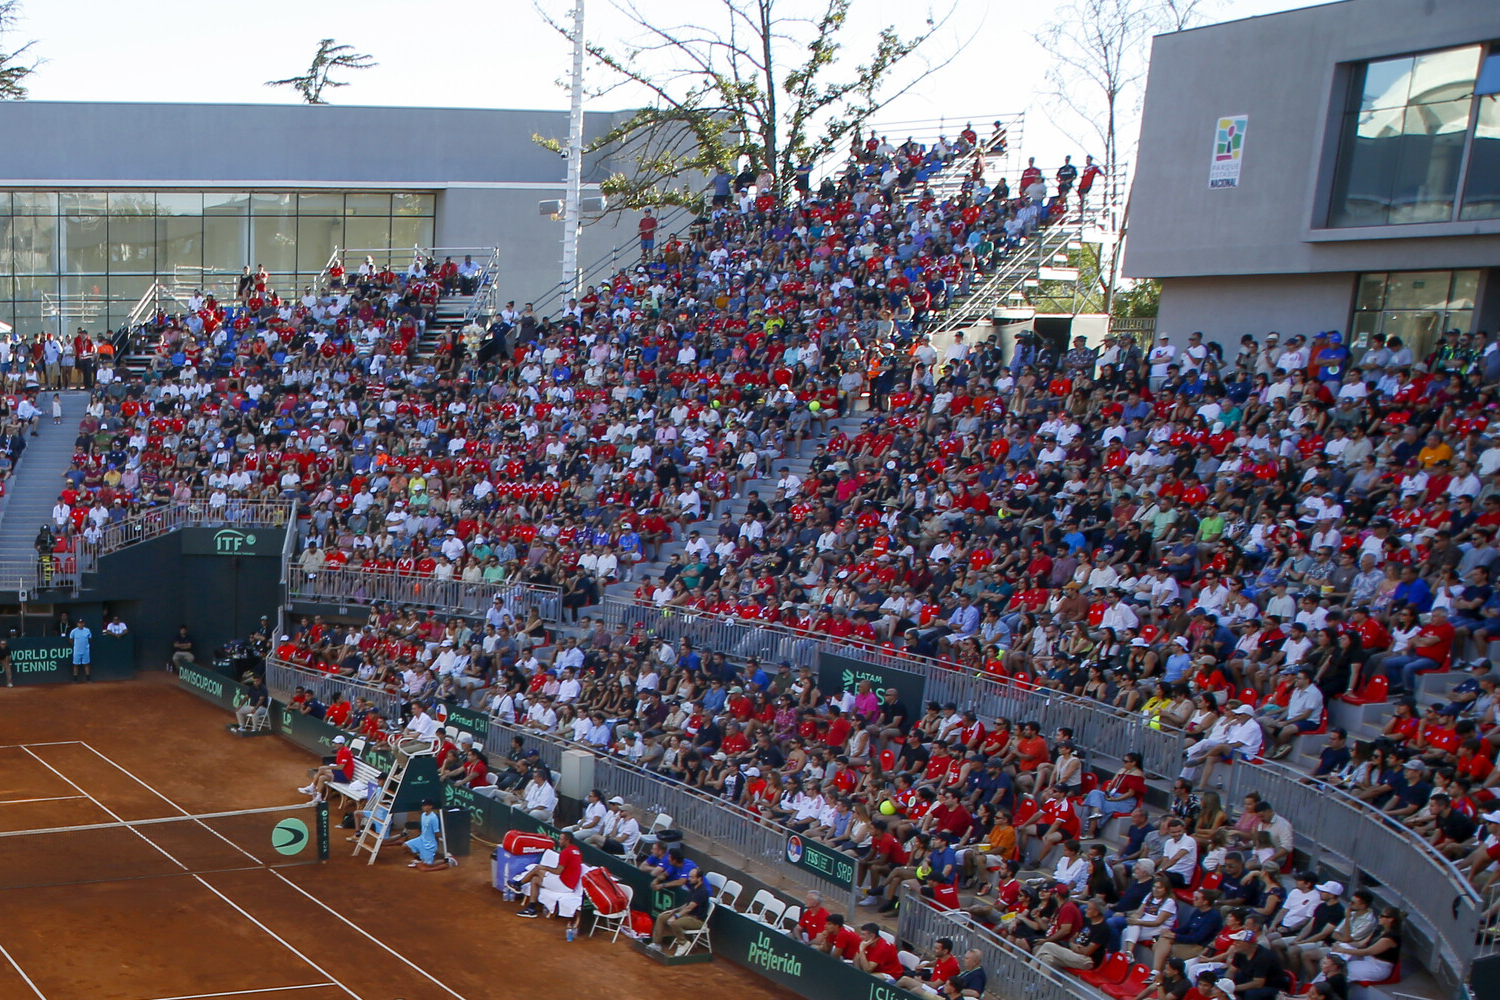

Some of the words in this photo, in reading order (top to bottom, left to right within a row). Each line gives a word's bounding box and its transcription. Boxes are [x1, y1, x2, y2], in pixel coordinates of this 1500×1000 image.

[217, 537, 243, 551] ITF
[50, 648, 73, 659] CUP
[14, 661, 57, 673] TENNIS
[179, 666, 223, 698] DAVISCUP.COM
[856, 671, 882, 684] LATAM
[475, 718, 487, 733] CHI
[807, 850, 819, 866] TSS
[837, 861, 853, 883] SRB
[655, 891, 672, 910] LP
[758, 931, 770, 949] La
[748, 942, 802, 977] Preferida
